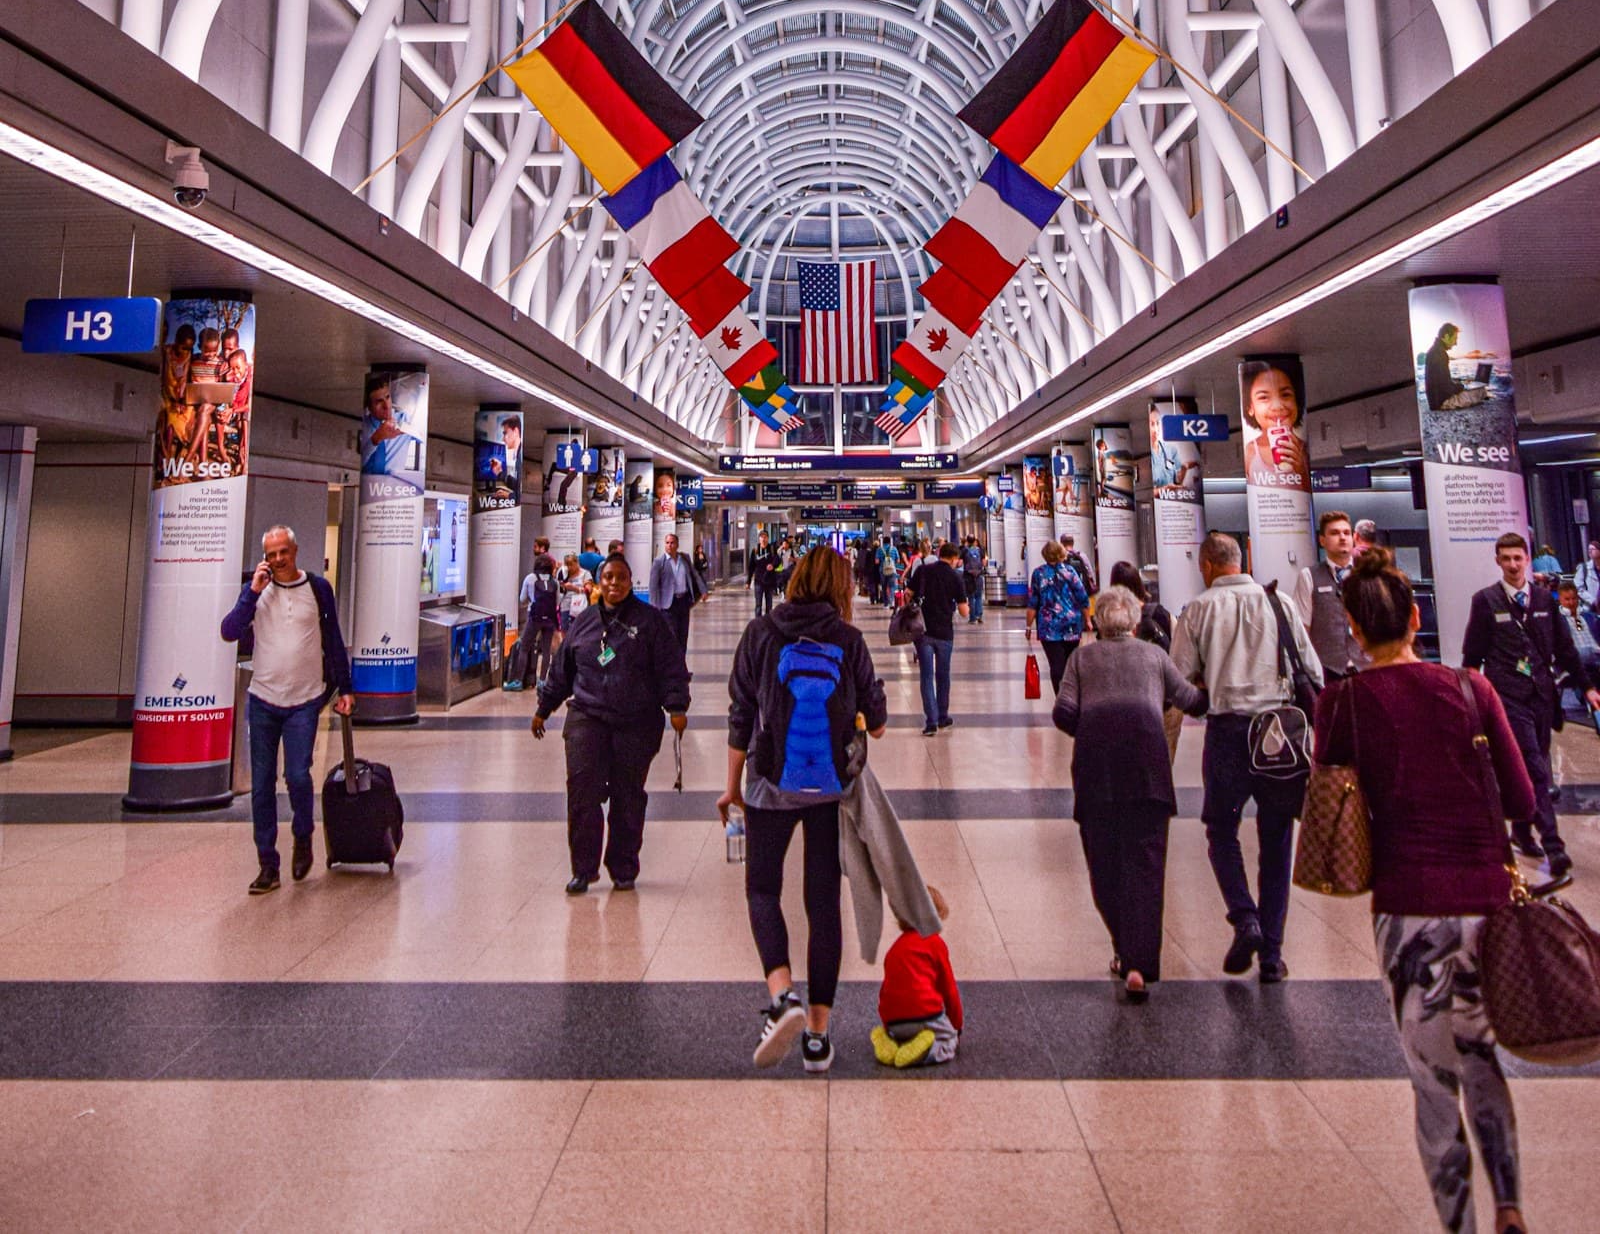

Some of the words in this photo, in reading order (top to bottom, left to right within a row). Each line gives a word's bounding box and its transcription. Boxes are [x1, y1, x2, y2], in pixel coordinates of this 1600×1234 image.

[65, 311, 113, 341] H3
[1182, 419, 1209, 437] K2
[1437, 443, 1473, 463] We
[1477, 446, 1510, 462] see
[162, 457, 194, 478] We
[198, 461, 232, 477] see
[1254, 471, 1276, 485] We
[1279, 472, 1302, 484] see
[369, 483, 392, 497] We
[395, 485, 417, 497] see
[1475, 482, 1494, 490] being
[1159, 489, 1175, 500] We
[1177, 490, 1196, 500] see
[1473, 490, 1493, 498] safety
[207, 496, 228, 505] people
[479, 496, 497, 508] We
[498, 498, 516, 508] see
[687, 496, 696, 506] G
[1098, 497, 1112, 507] We
[1112, 499, 1127, 507] see
[178, 504, 200, 512] having
[549, 503, 563, 512] We
[565, 504, 578, 512] see
[600, 508, 612, 516] We
[1468, 518, 1488, 526] people
[361, 647, 409, 655] EMERSON
[144, 695, 216, 708] EMERSON
[136, 713, 174, 723] CONSIDER
[178, 714, 188, 722] IT
[190, 712, 225, 722] SOLVED
